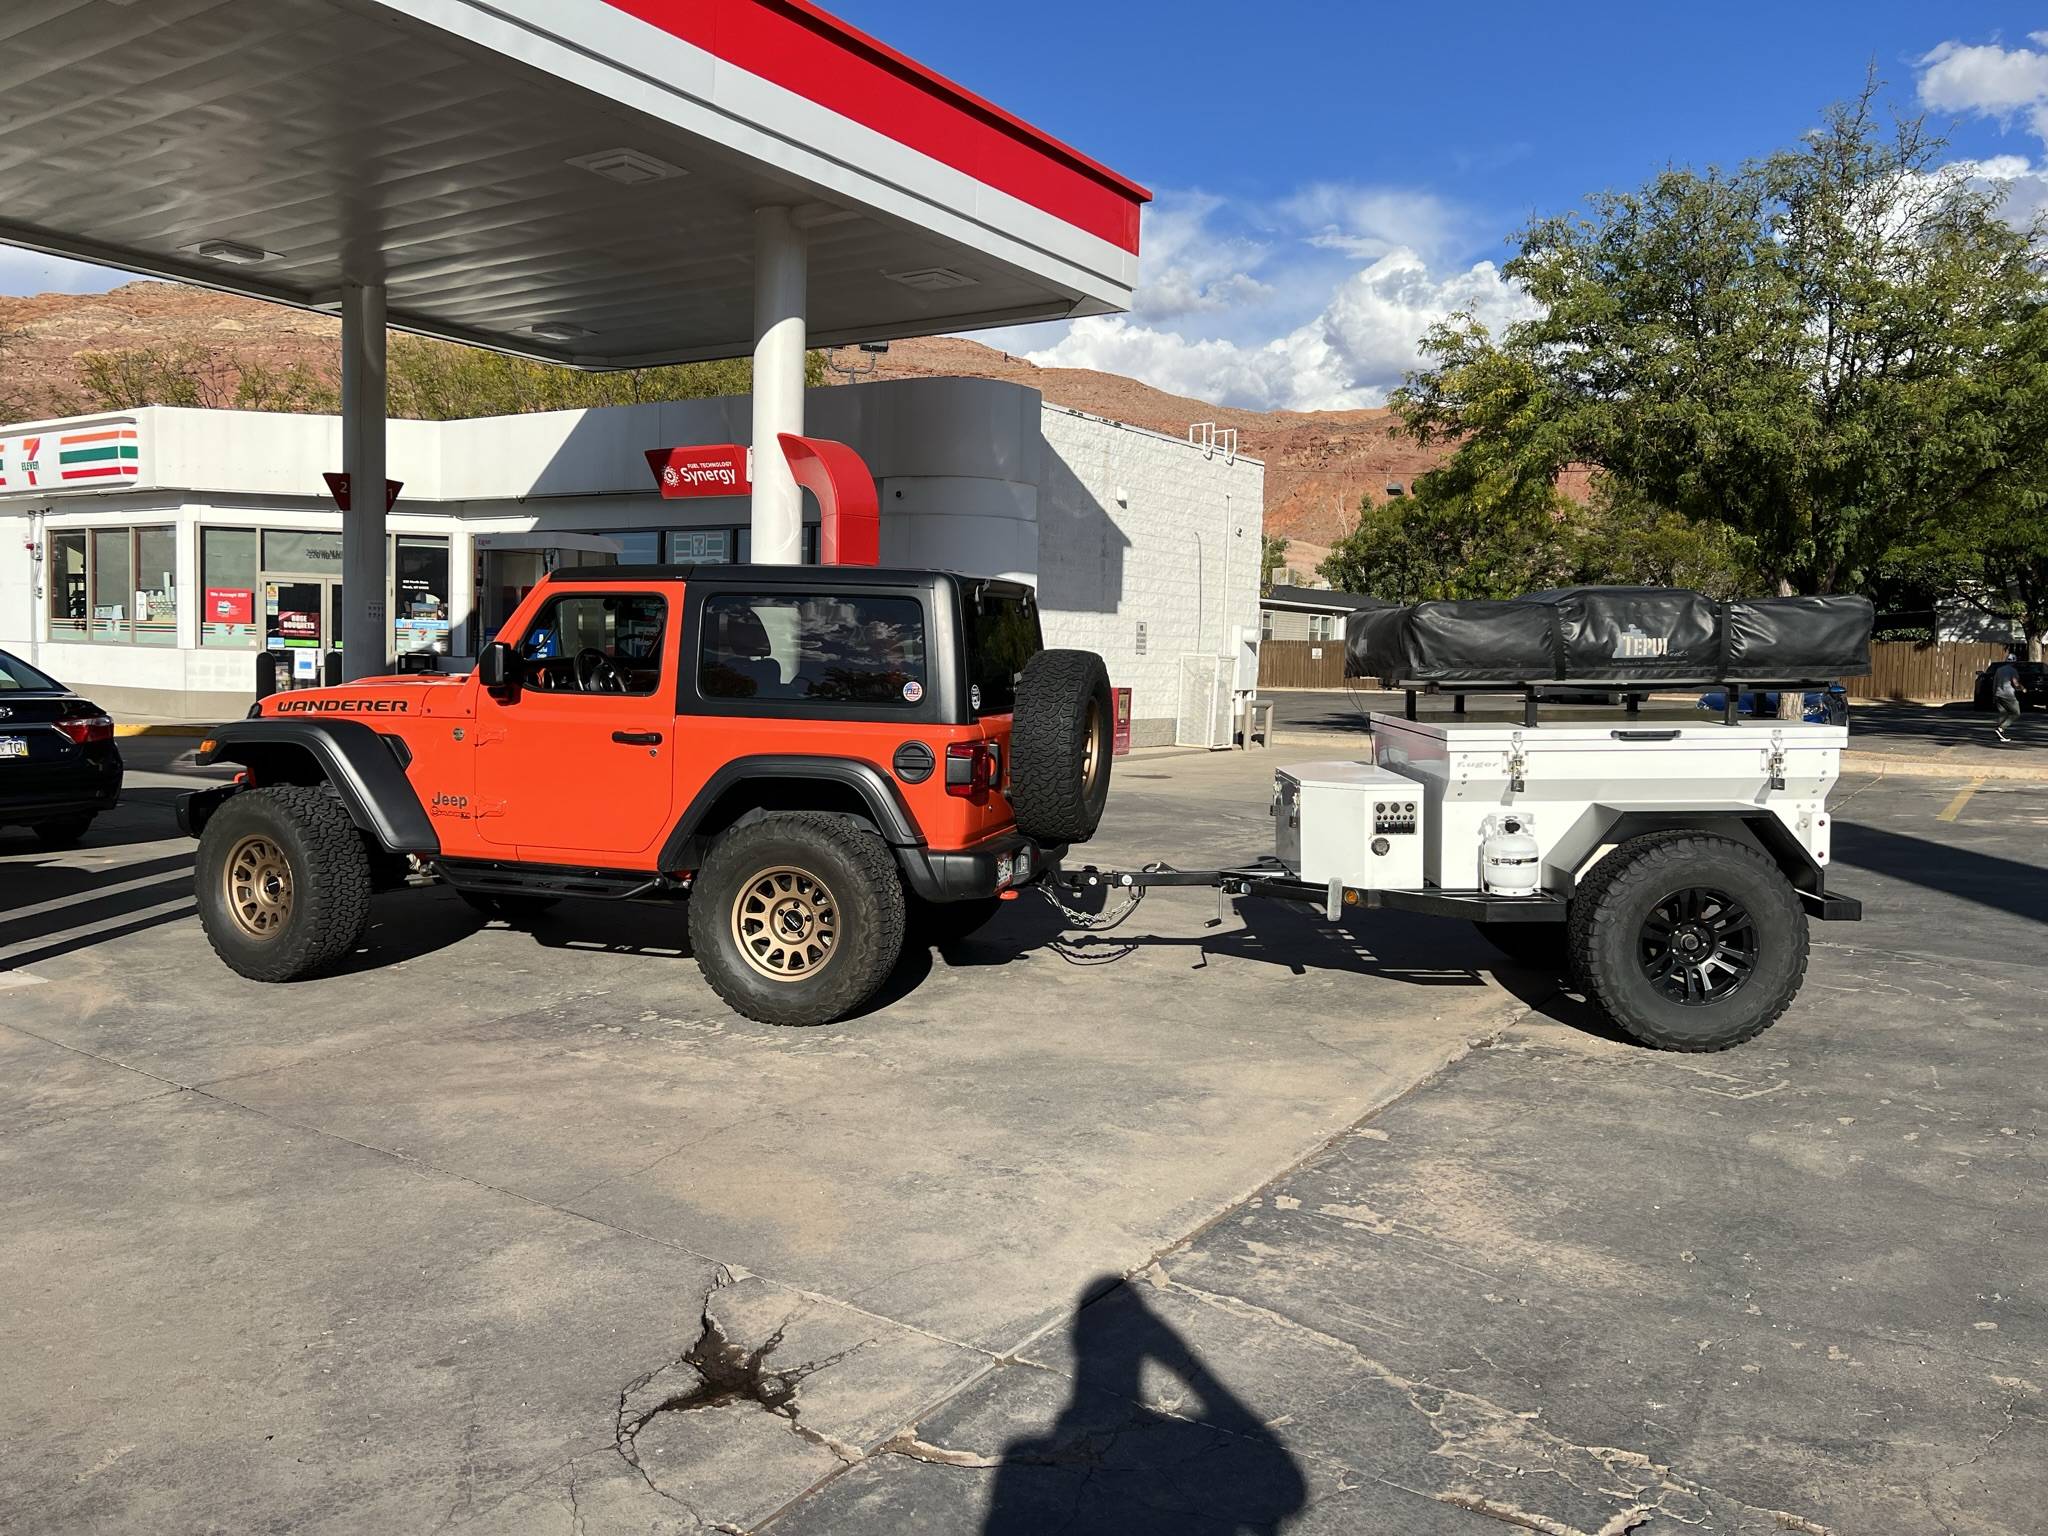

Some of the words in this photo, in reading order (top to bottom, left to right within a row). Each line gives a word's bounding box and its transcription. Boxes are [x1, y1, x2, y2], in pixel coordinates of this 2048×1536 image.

[21, 460, 39, 471] ELEVEN
[23, 438, 40, 485] 7
[680, 467, 735, 485] Synergy
[340, 482, 348, 493] 2
[388, 489, 393, 500] 1
[1622, 635, 1668, 656] TEPUI
[277, 700, 408, 712] WANDERER
[431, 791, 468, 809] Jeep
